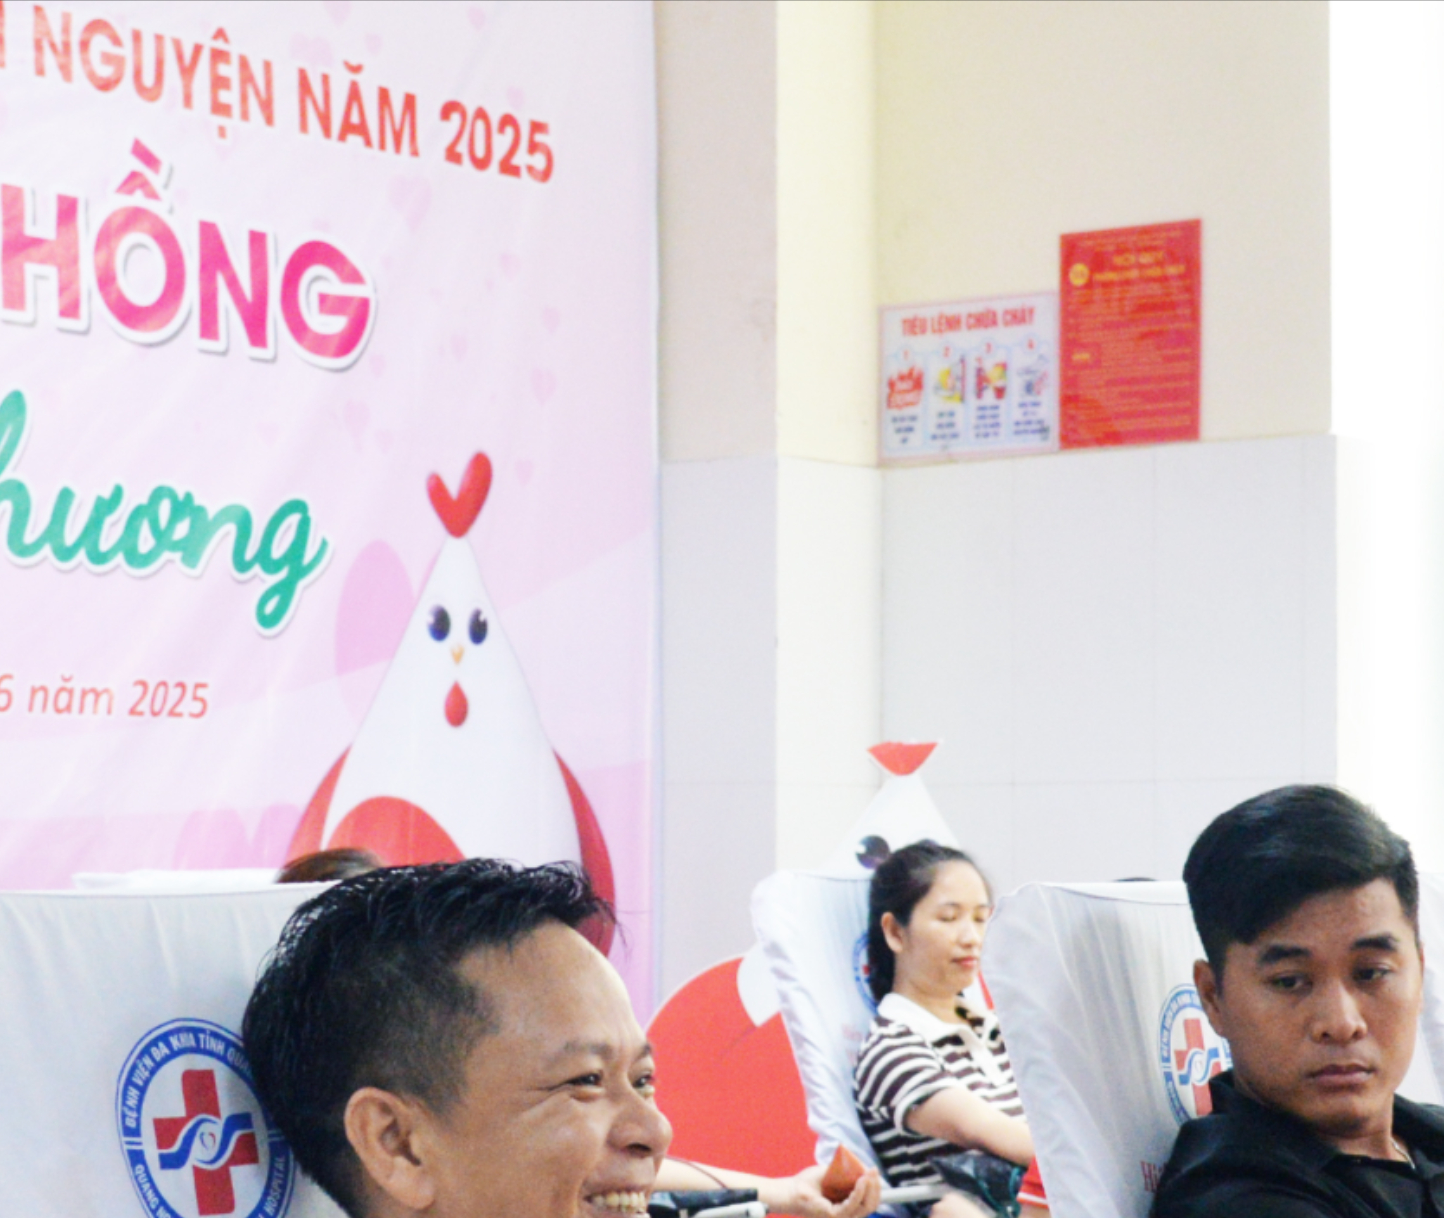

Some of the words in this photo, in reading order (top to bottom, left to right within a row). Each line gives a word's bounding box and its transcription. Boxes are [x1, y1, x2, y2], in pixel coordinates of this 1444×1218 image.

[34, 5, 275, 137] NGUYỆN
[298, 61, 420, 158] NĂM
[440, 100, 555, 184] 2025
[1, 138, 372, 360] HỒNG
[27, 676, 115, 717] năm
[129, 679, 209, 720] 2025
[262, 1155, 286, 1217] HOSPITAL
